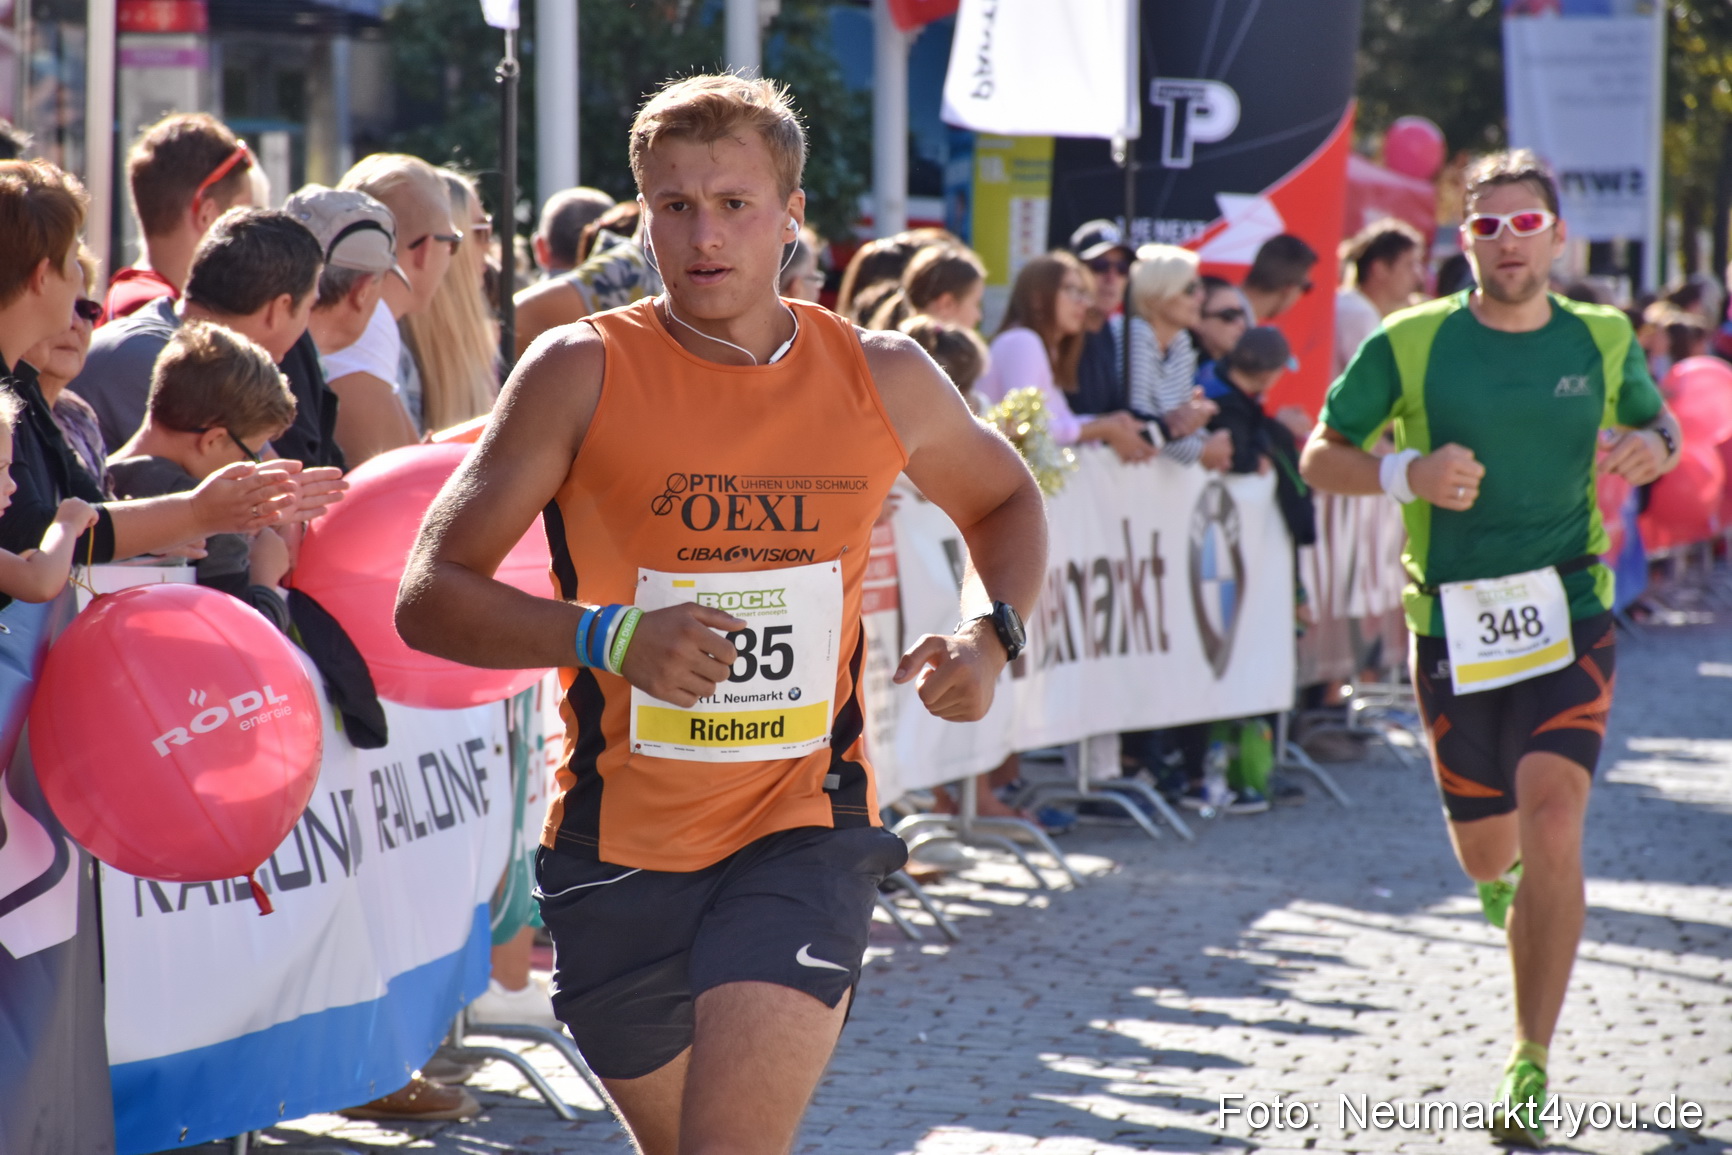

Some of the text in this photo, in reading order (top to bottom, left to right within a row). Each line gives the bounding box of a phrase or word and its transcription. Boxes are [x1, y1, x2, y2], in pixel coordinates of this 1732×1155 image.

[741, 480, 781, 490] UHREN
[786, 480, 812, 490] UND
[816, 480, 868, 490] SCHMUCK
[681, 494, 820, 532] OEXL
[697, 588, 786, 611] BOCK
[1477, 606, 1544, 645] 348
[724, 691, 783, 703] Neumarkt
[239, 704, 292, 731] energie
[690, 715, 785, 741] Richard
